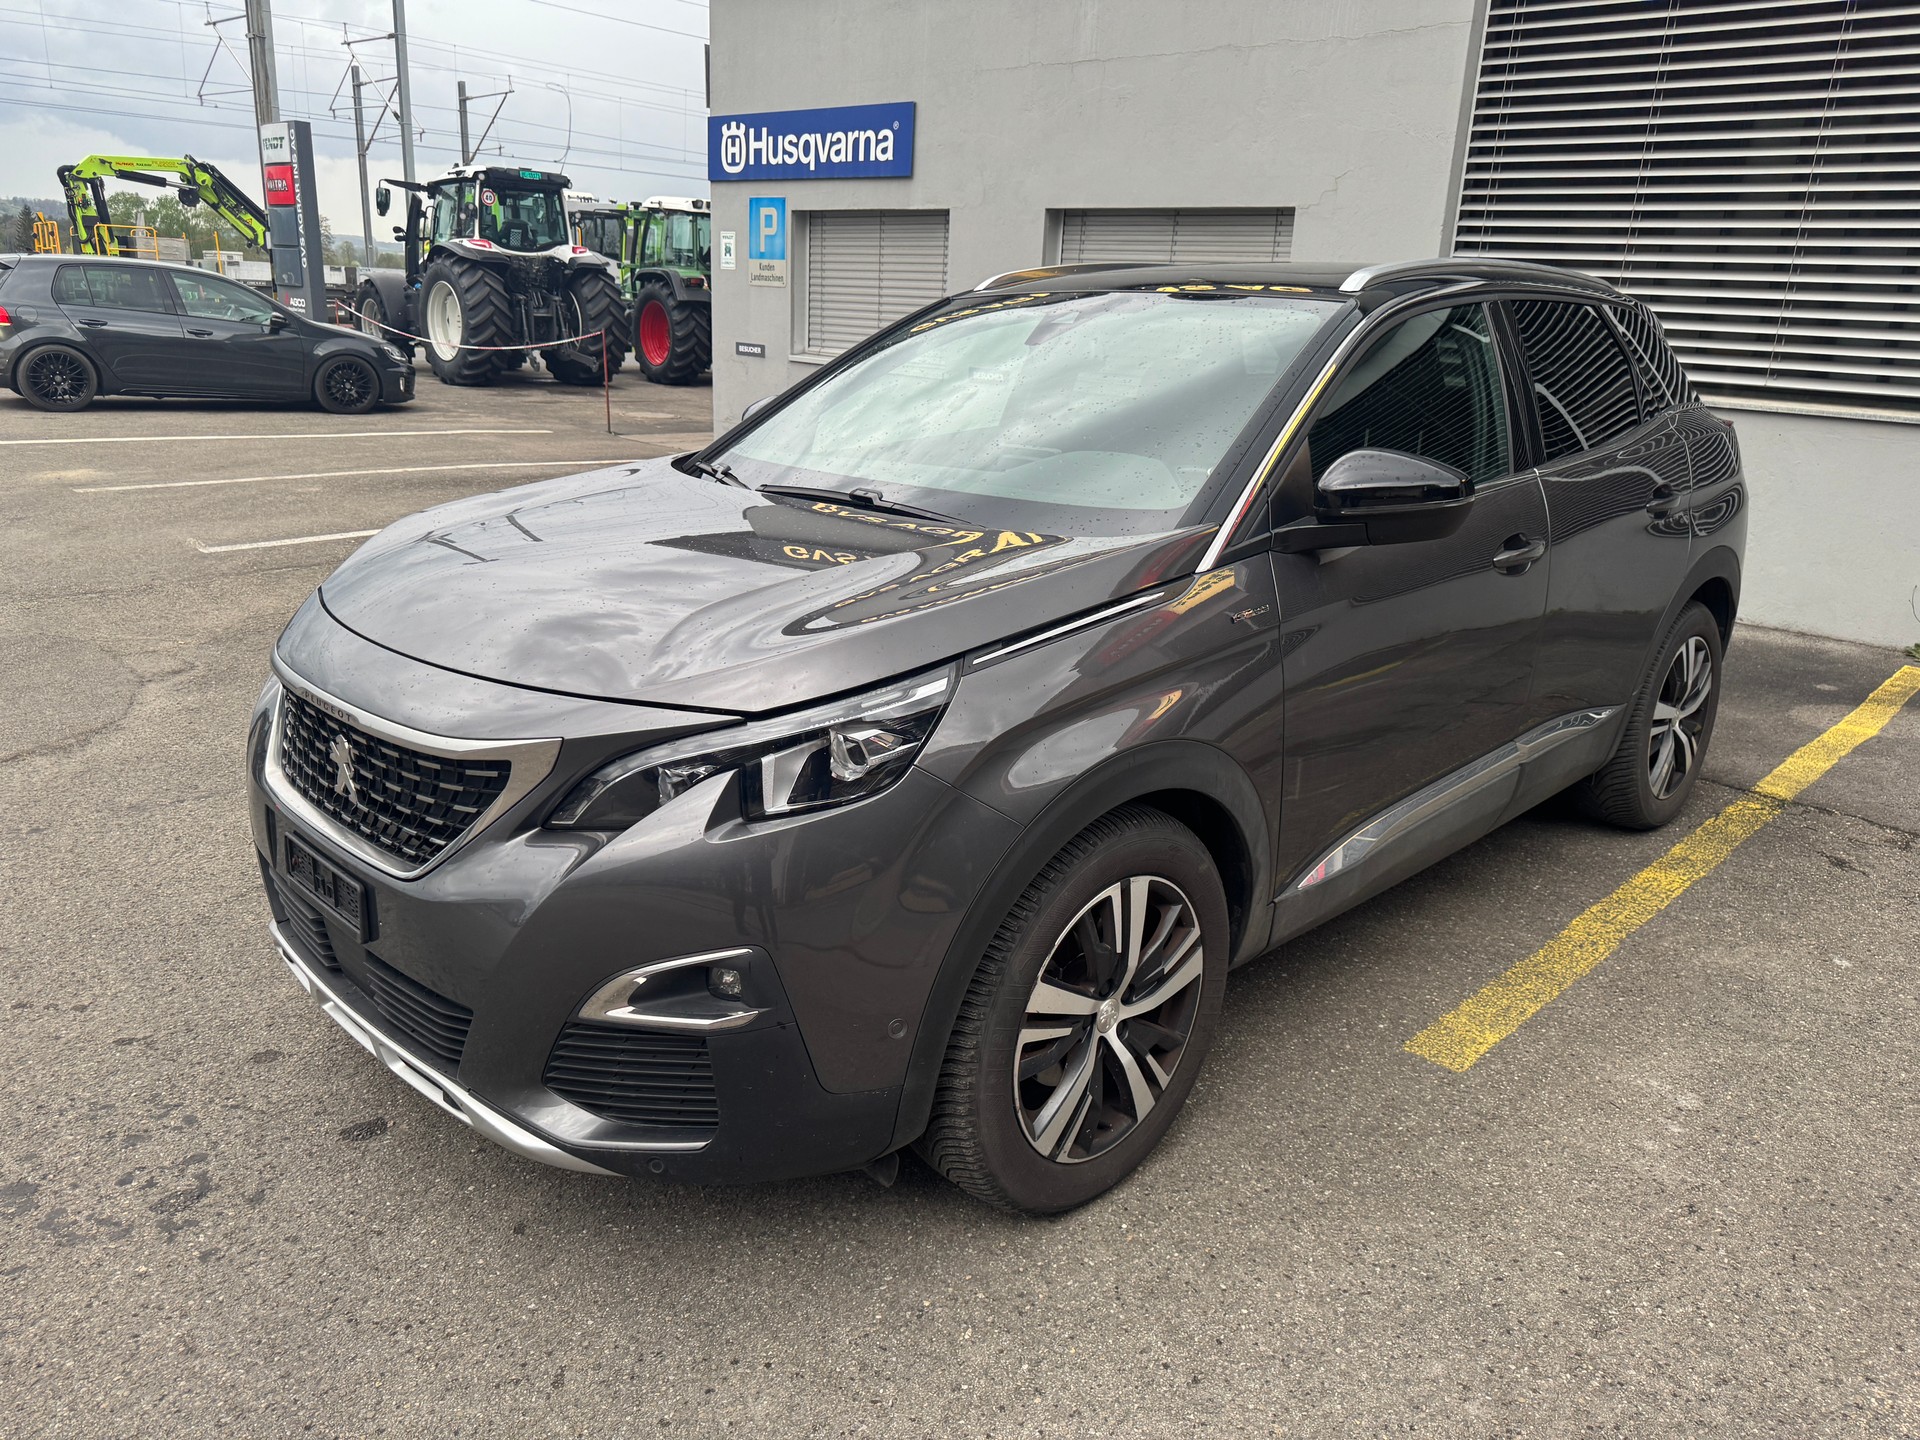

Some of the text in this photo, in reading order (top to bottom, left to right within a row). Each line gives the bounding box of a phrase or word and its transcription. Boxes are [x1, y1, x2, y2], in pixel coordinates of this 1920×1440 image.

[289, 128, 297, 150] AG
[749, 127, 894, 171] Husqvarna
[295, 183, 305, 235] AGRAR
[760, 207, 778, 253] P
[300, 237, 308, 268] GVS
[759, 262, 775, 272] Kunden
[750, 272, 784, 283] Landmaschinen
[304, 690, 351, 722] PEUGEOT
